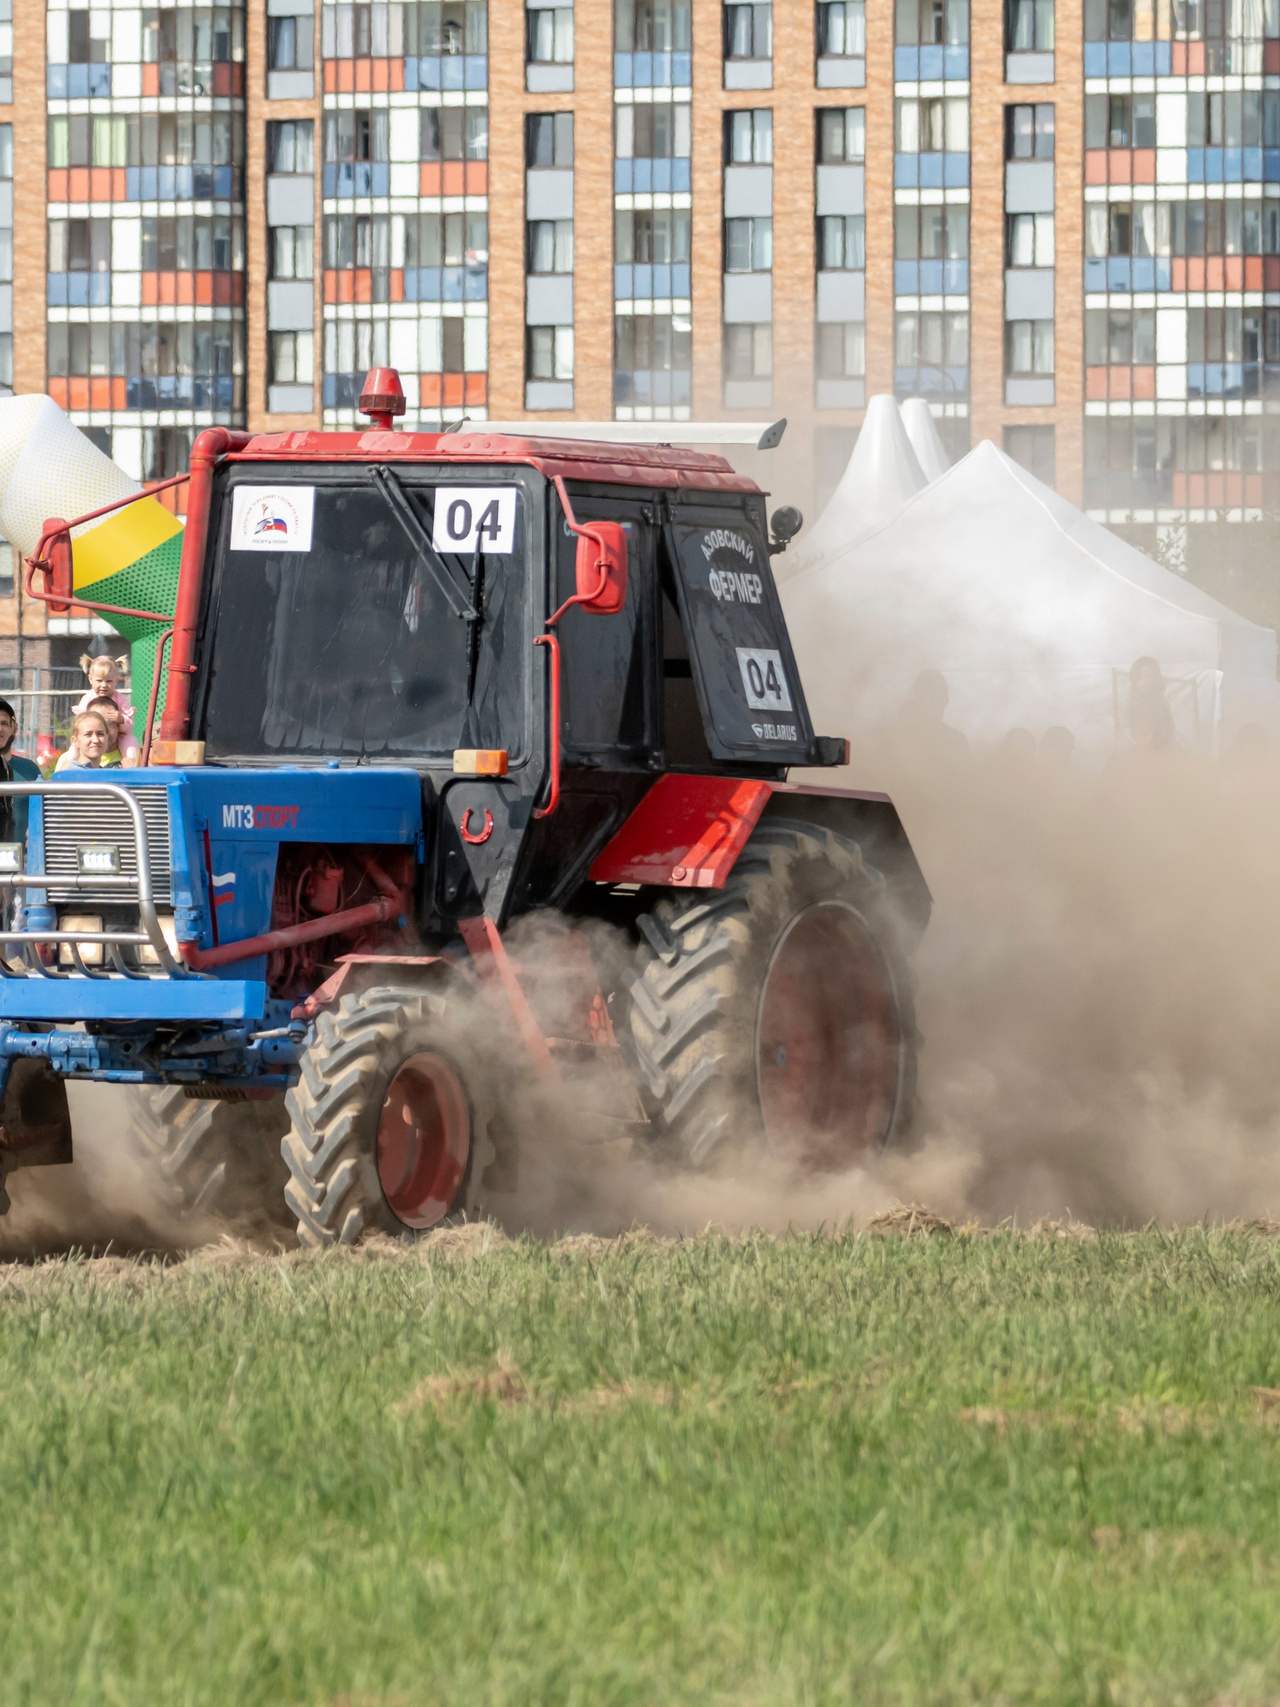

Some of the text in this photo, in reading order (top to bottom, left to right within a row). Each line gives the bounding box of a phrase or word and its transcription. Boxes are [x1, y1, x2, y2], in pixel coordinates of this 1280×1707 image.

[446, 499, 502, 541] 04
[700, 529, 754, 564] АЗОВСКИЙ
[708, 568, 763, 604] ФЕРМЕР
[746, 658, 782, 701] 04
[763, 724, 797, 741] BELARUS
